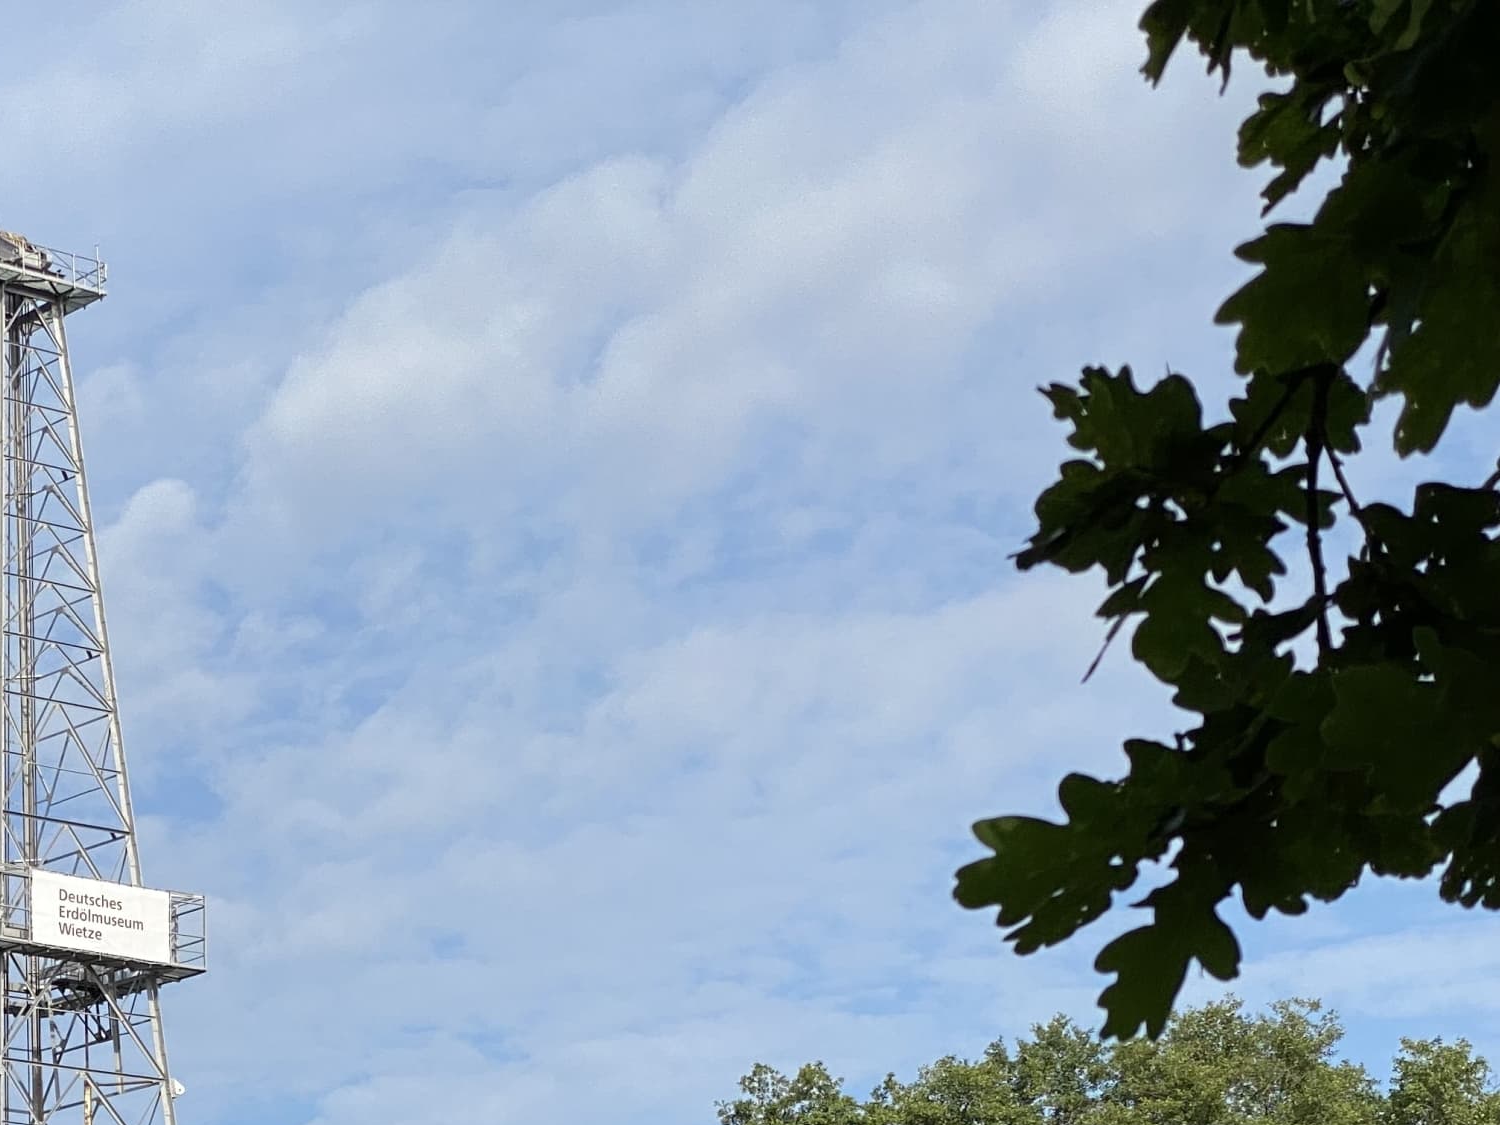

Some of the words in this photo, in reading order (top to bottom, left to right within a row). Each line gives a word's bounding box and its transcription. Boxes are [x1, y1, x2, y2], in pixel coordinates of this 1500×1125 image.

[59, 888, 122, 910] Deutsches
[59, 905, 144, 930] Erdölmuseum
[59, 922, 102, 940] Wietze
